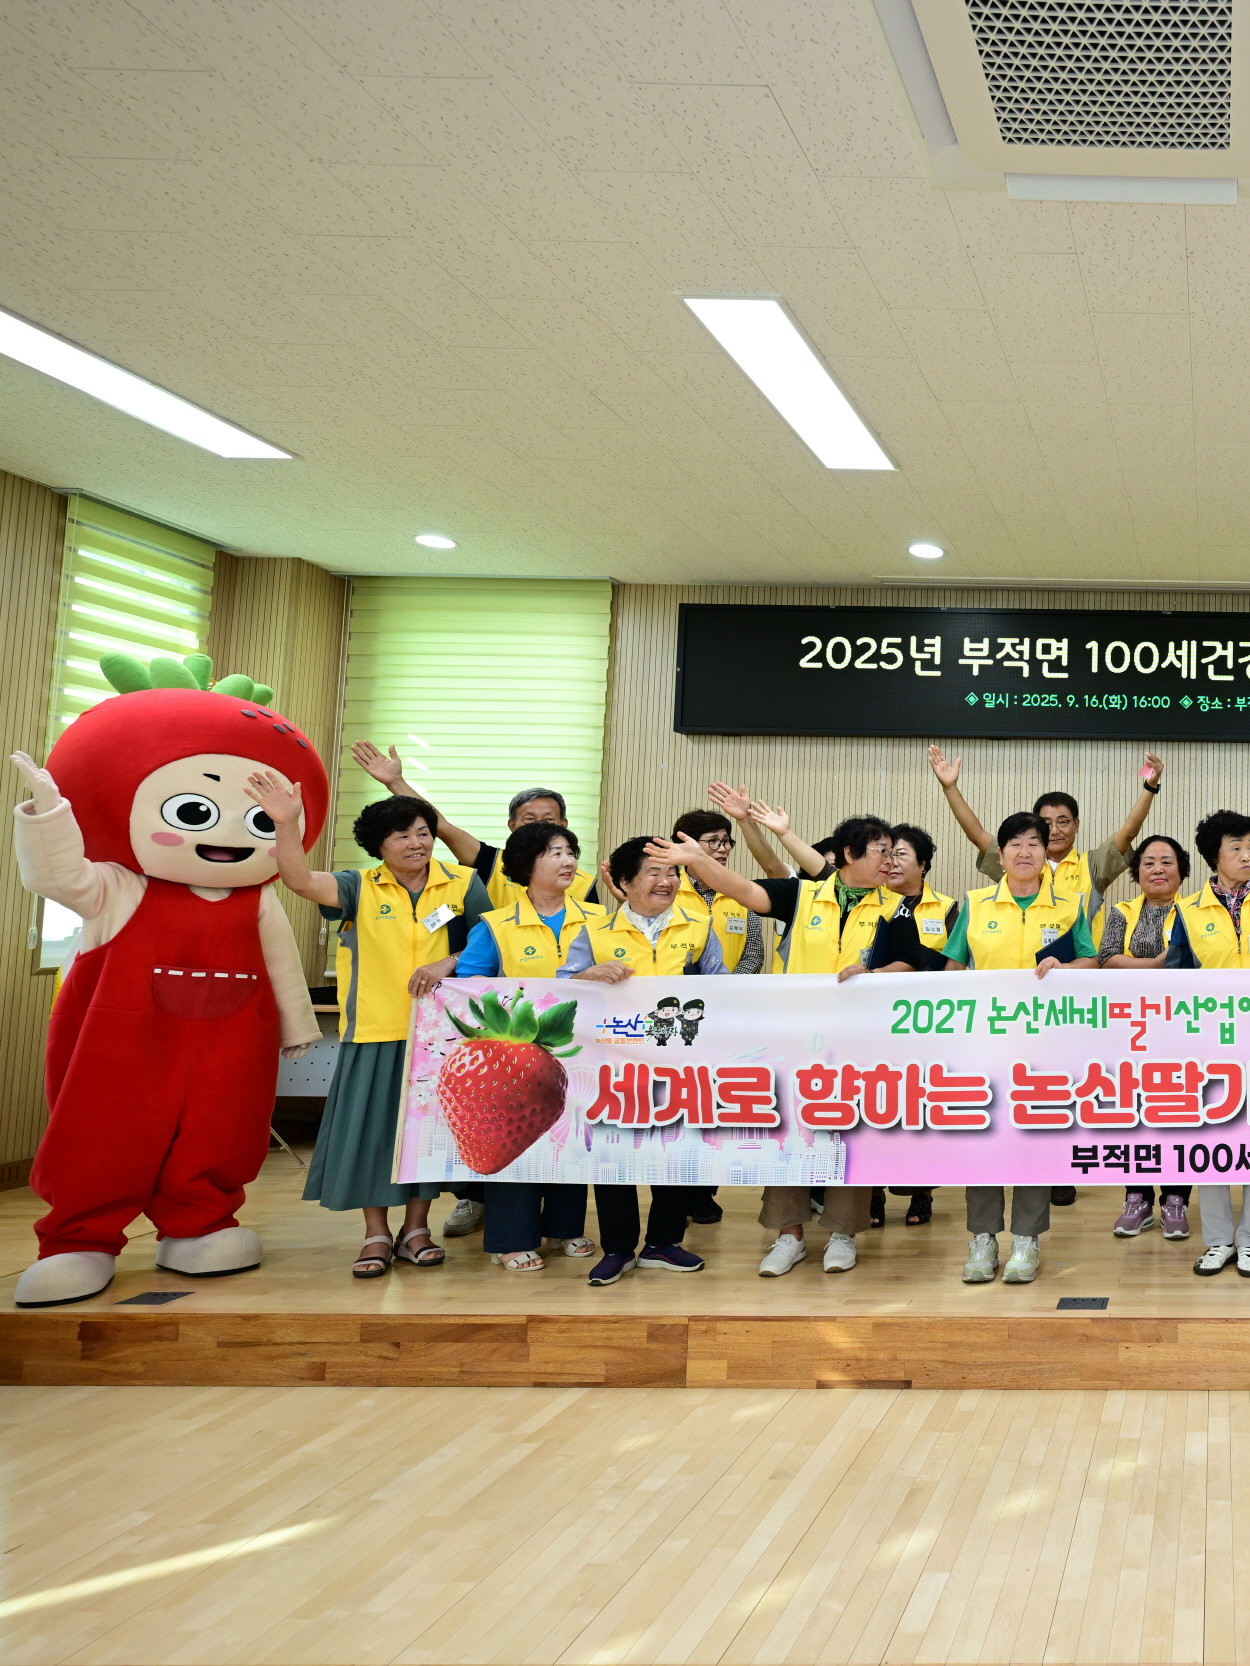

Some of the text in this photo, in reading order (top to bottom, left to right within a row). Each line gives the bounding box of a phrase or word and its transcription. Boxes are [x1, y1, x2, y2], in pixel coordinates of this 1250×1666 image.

[799, 635, 942, 677] 2025년
[958, 636, 1069, 679] 부적면
[982, 692, 1009, 709] 일시
[1022, 694, 1062, 708] 2025.
[1066, 694, 1079, 708] 9.
[1083, 693, 1128, 711] 16.(화)
[1132, 695, 1171, 709] 16:00
[1197, 695, 1224, 712] 장소
[670, 942, 696, 951] 부적면
[891, 998, 977, 1035] 2027
[586, 1062, 777, 1126] 세계로
[796, 1063, 990, 1128] 향하는
[1071, 1144, 1162, 1175] 부적면
